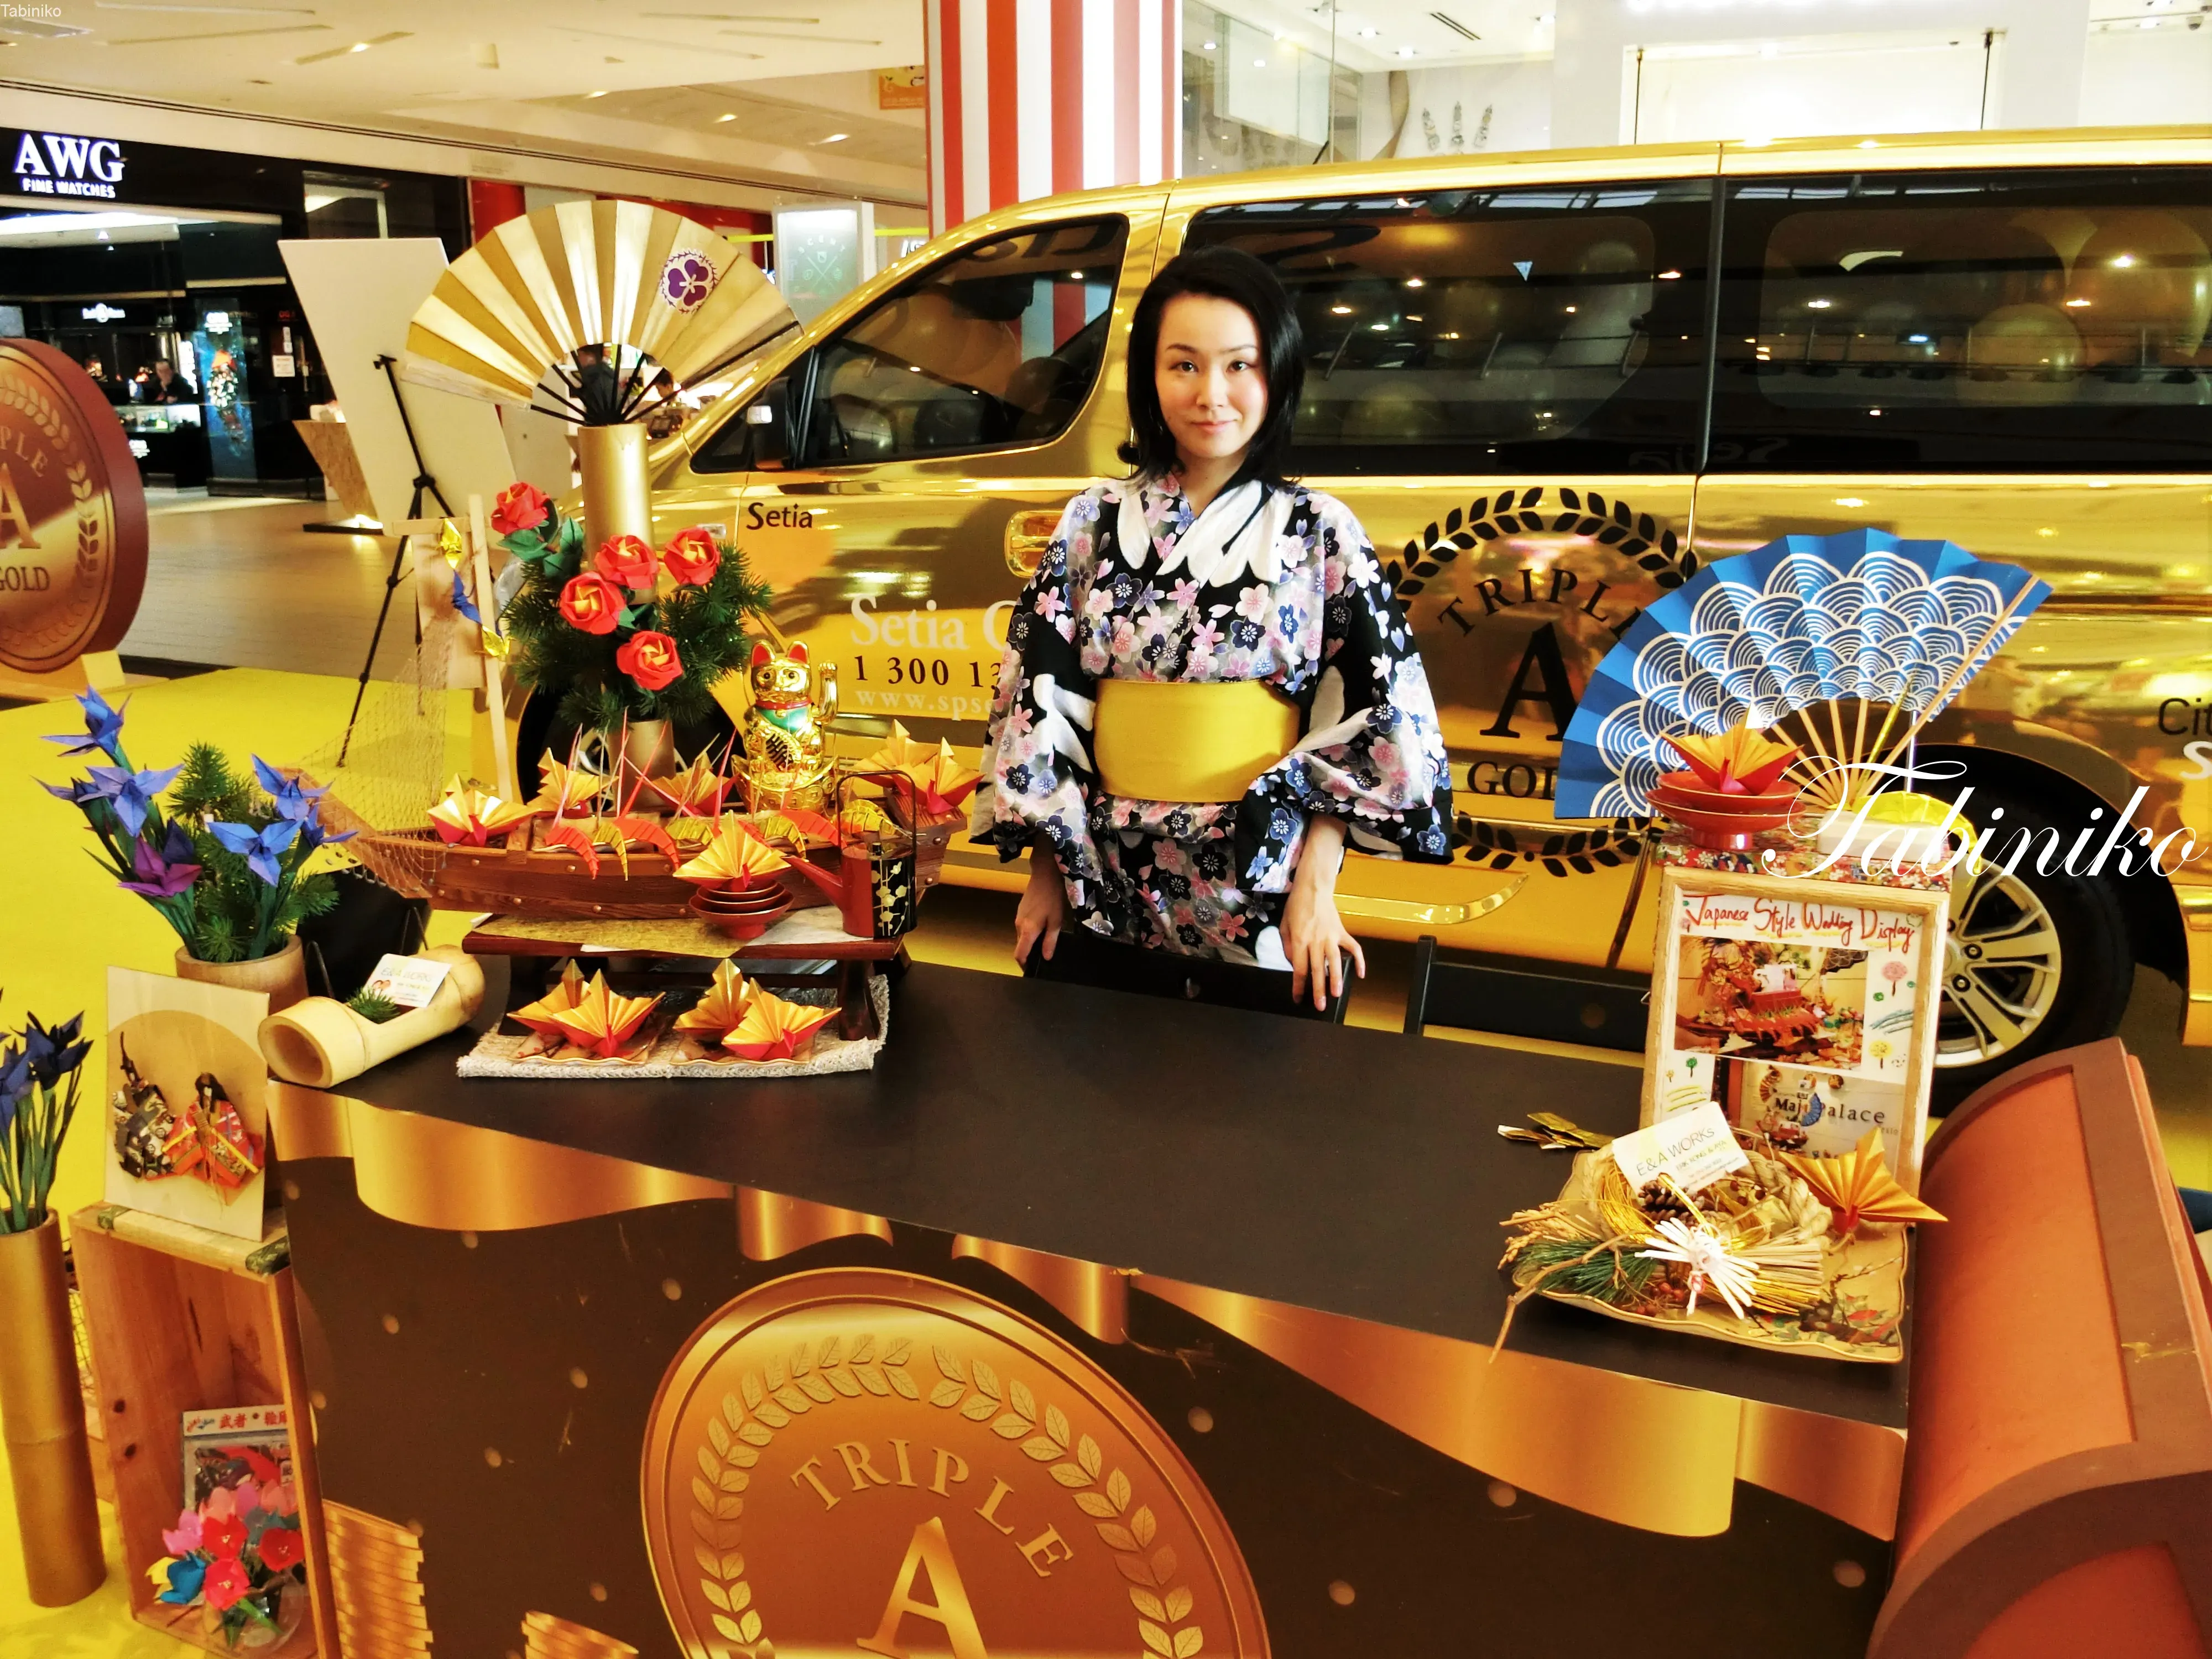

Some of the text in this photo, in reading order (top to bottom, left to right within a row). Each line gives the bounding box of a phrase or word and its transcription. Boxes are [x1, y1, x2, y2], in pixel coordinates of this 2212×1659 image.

[13, 133, 125, 182] AWG
[22, 177, 116, 199] FINE WATCHES
[746, 502, 813, 530] Setia
[0, 565, 51, 591] OLD
[851, 593, 970, 650] Setia
[854, 655, 868, 681] 1
[886, 656, 950, 685] 300
[1480, 622, 1579, 742] A
[1683, 893, 1749, 929] Japanese
[1753, 898, 1796, 938] Style
[1859, 907, 1915, 953] Display
[1827, 1104, 1885, 1124] alace
[789, 1438, 1074, 1578] TRIPLE
[855, 1516, 989, 1659] A
